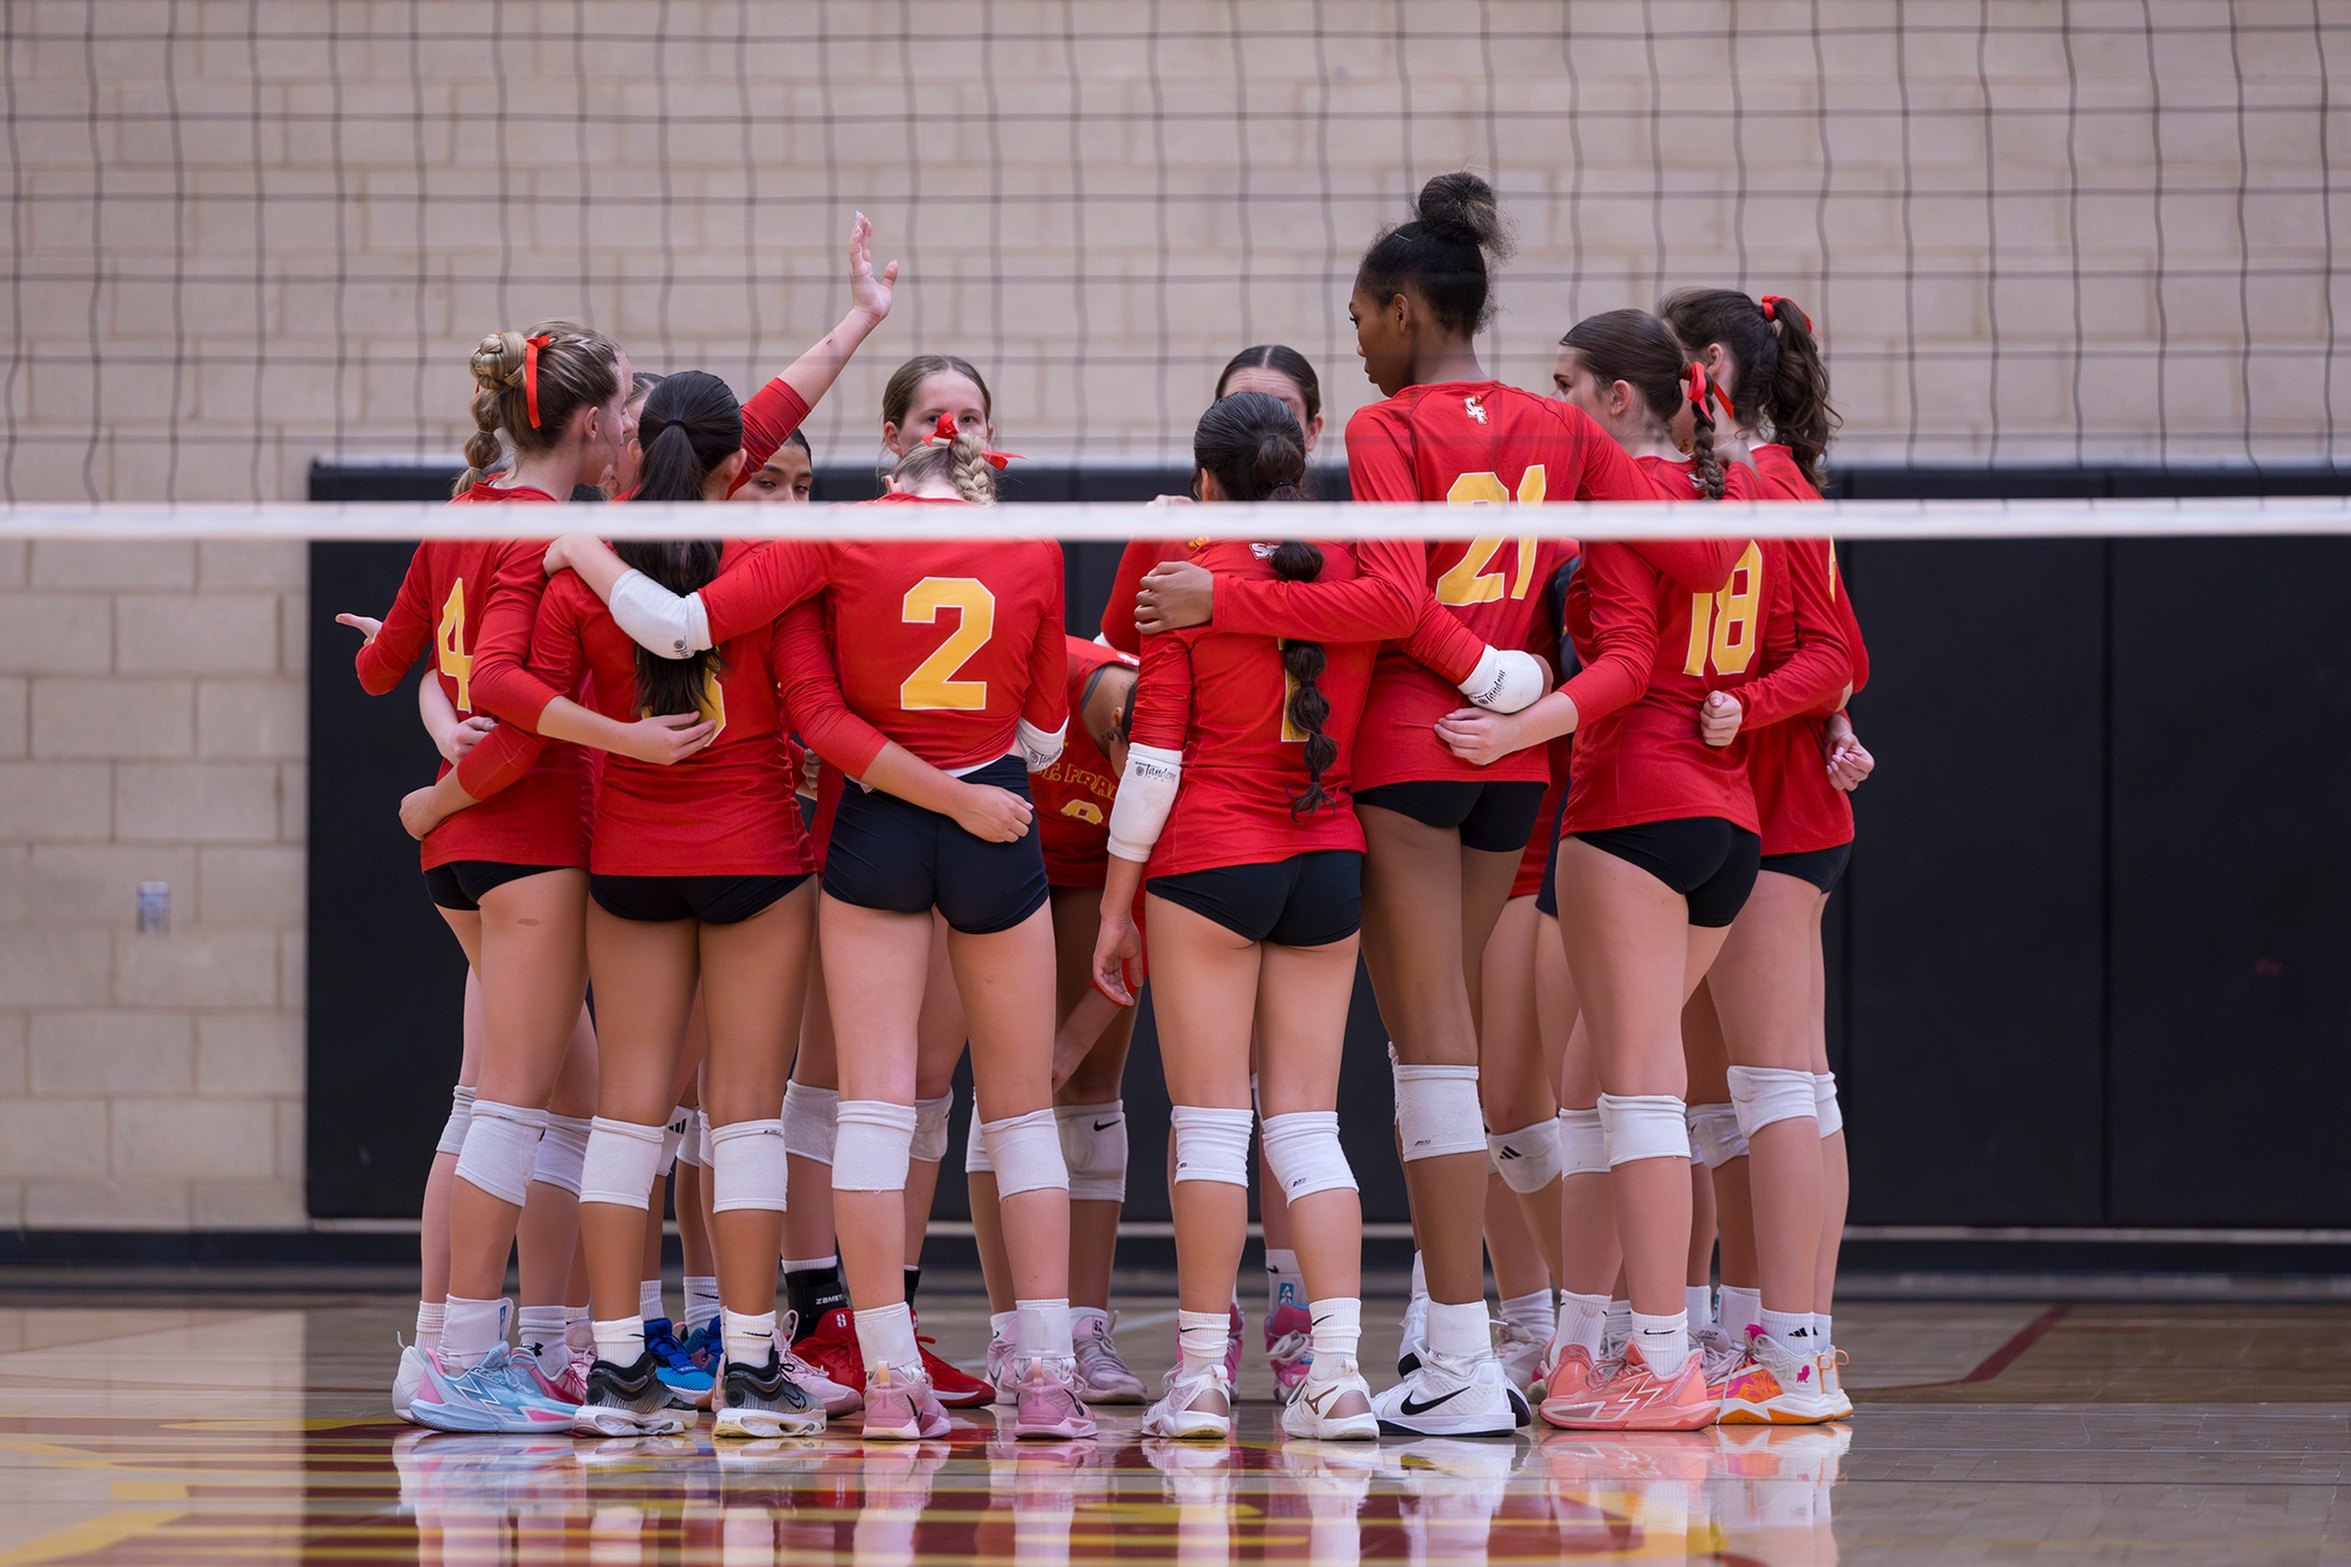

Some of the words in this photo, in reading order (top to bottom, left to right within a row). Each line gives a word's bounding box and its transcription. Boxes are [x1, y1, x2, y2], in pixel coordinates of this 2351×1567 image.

[1436, 464, 1546, 606] 21
[437, 577, 473, 714] 4
[900, 576, 996, 711] 2
[1683, 539, 1763, 676] 18
